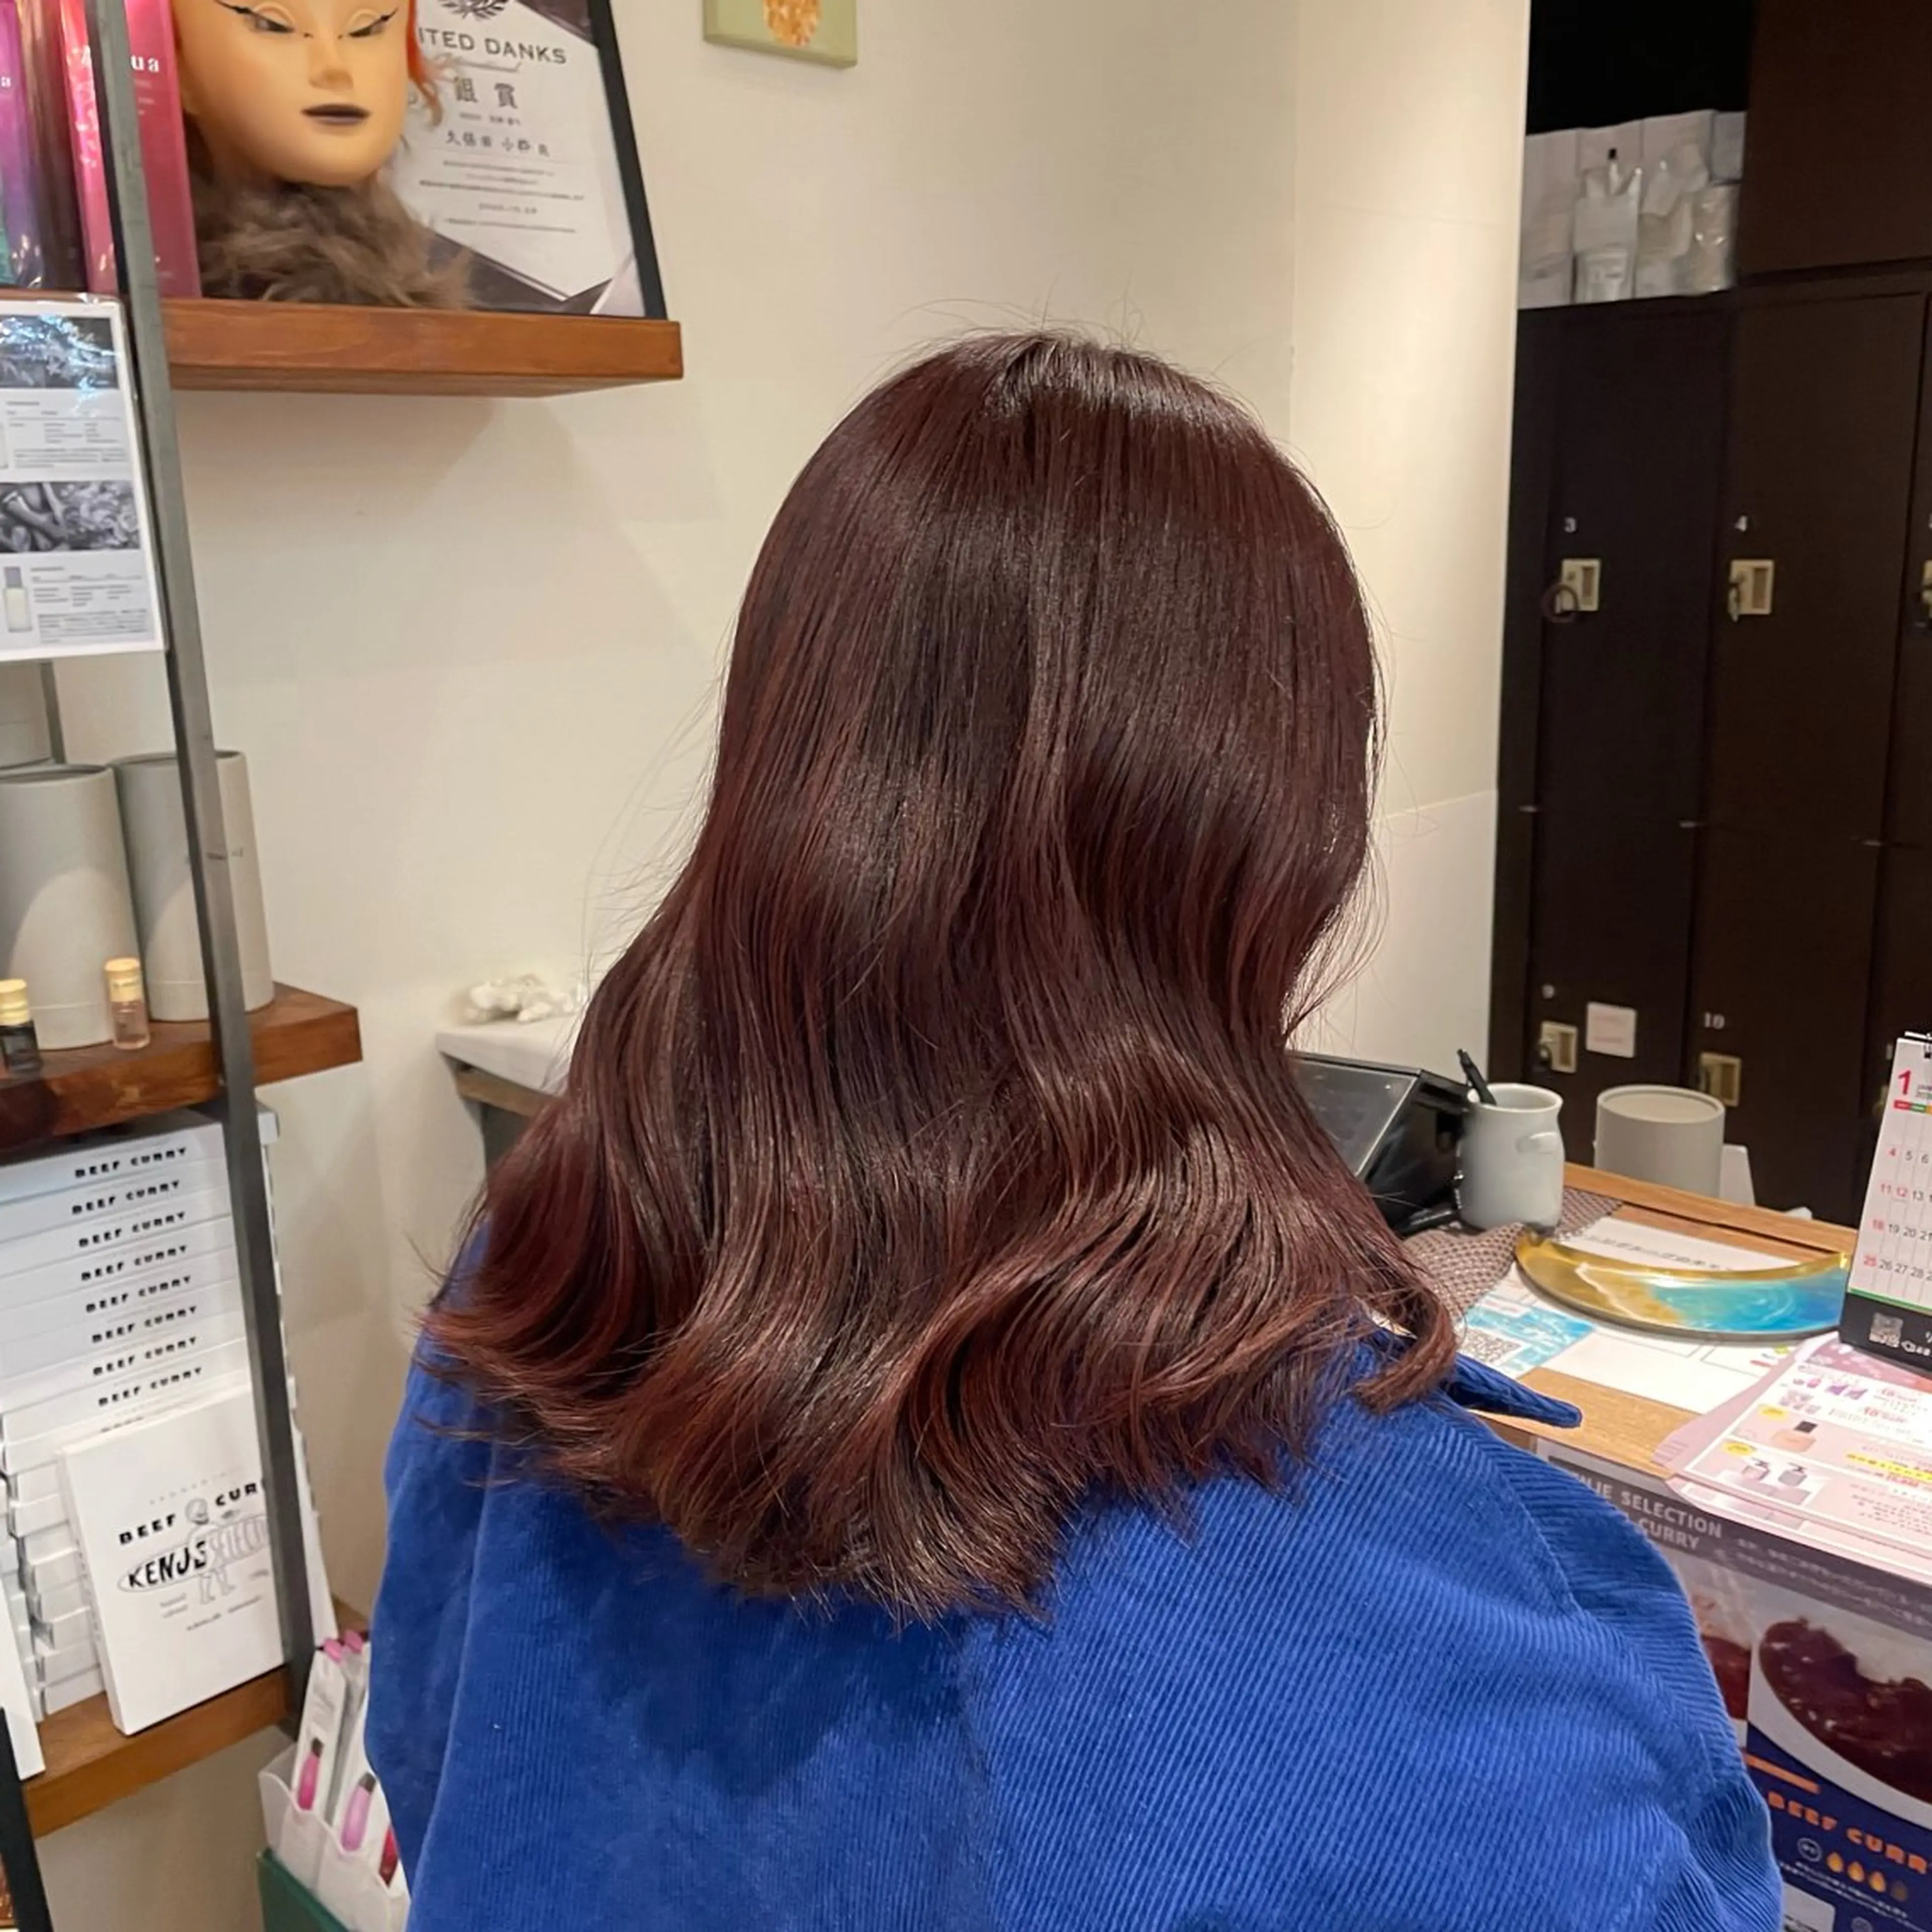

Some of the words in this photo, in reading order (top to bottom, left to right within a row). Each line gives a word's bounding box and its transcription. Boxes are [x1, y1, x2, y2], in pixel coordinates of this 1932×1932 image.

[419, 27, 475, 51] ITED
[484, 38, 568, 65] DANKS
[1564, 517, 1577, 533] 3
[1734, 515, 1748, 532] 4
[1704, 1011, 1726, 1030] 10
[1898, 1070, 1911, 1096] 1
[74, 1160, 120, 1178] BEEF
[130, 1147, 186, 1166] CURRY
[1905, 1149, 1913, 1162] 5
[71, 1195, 116, 1215] BEEF
[125, 1180, 180, 1200] CURRY
[78, 1228, 122, 1248] BEEF
[131, 1211, 185, 1233] CURRY
[80, 1261, 124, 1281] BEEF
[134, 1245, 187, 1266] CURRY
[85, 1293, 129, 1313] BEEF
[138, 1275, 191, 1297] CURRY
[91, 1323, 135, 1343] BEEF
[144, 1305, 197, 1327] CURRY
[92, 1355, 135, 1376] BEEF
[145, 1336, 196, 1359] CURRY
[98, 1386, 140, 1407] BEEF
[150, 1366, 202, 1390] CURRY
[119, 1512, 176, 1545] BEEF
[215, 1482, 258, 1506] CUR
[1620, 1491, 1722, 1539] SELECTION
[1637, 1517, 1701, 1551] CURRY
[1767, 1791, 1838, 1831] BEEF
[1845, 1827, 1932, 1875] CURR
